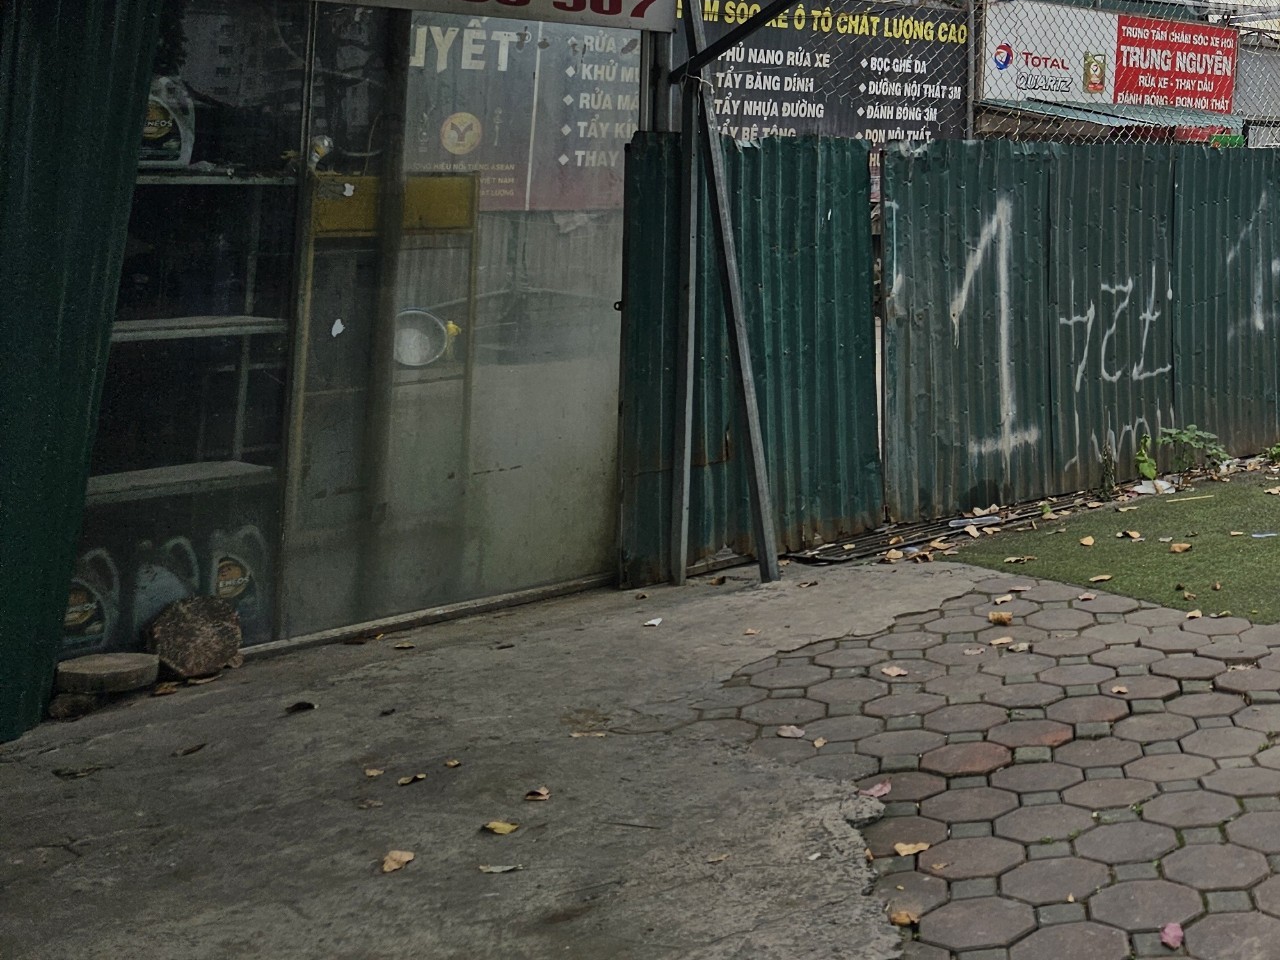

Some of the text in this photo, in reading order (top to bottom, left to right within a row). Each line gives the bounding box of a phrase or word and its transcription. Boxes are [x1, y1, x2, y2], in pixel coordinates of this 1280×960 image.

[795, 3, 806, 30] Ô
[811, 7, 833, 32] TÔ
[837, 8, 878, 37] CHẤT
[884, 16, 934, 44] LƯỢNG
[938, 22, 968, 44] CAO
[1122, 26, 1149, 39] TRUNG
[1210, 37, 1220, 48] XE
[748, 48, 784, 65] NANO
[786, 46, 811, 67] RỬA
[814, 52, 831, 68] XE
[914, 60, 927, 74] DA
[1120, 45, 1232, 76] TRUNG NGUYÊN
[716, 65, 814, 92] TẨY BĂNG DÍNH
[1016, 72, 1073, 92] QUARTZ
[1158, 77, 1169, 89] XE
[1175, 78, 1196, 90] THAY
[579, 87, 612, 110] RỬA
[714, 92, 824, 121] TẨY NHỰA ĐƯỜNG
[866, 103, 894, 120] ĐÁNH
[924, 108, 937, 122] 3M
[577, 114, 609, 137] TẨY
[574, 151, 620, 167] THAY
